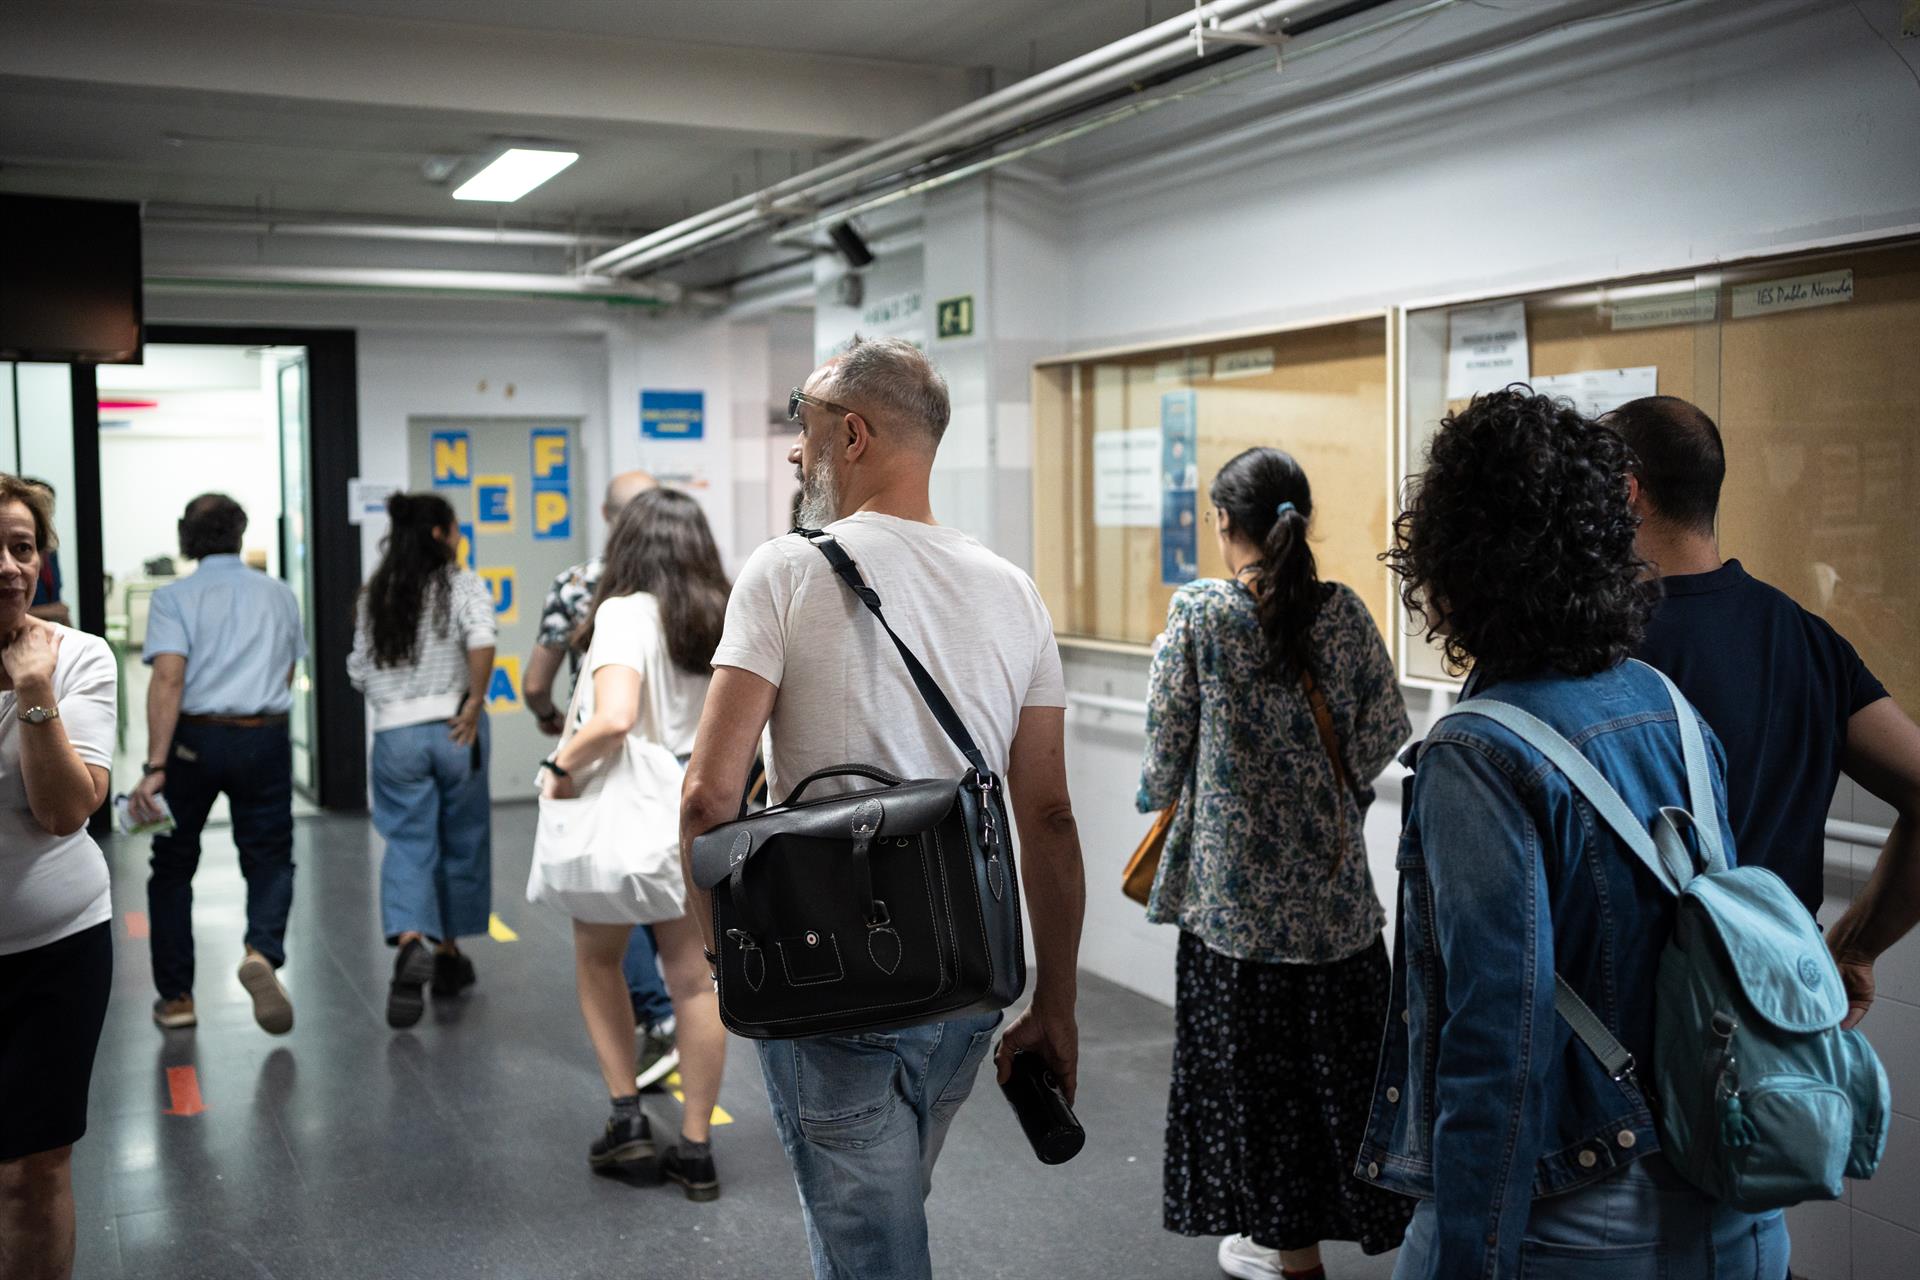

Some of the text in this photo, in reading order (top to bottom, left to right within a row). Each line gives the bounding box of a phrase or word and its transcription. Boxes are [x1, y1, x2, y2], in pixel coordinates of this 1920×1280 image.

[1757, 280, 1852, 305] IES Pablo Neruda
